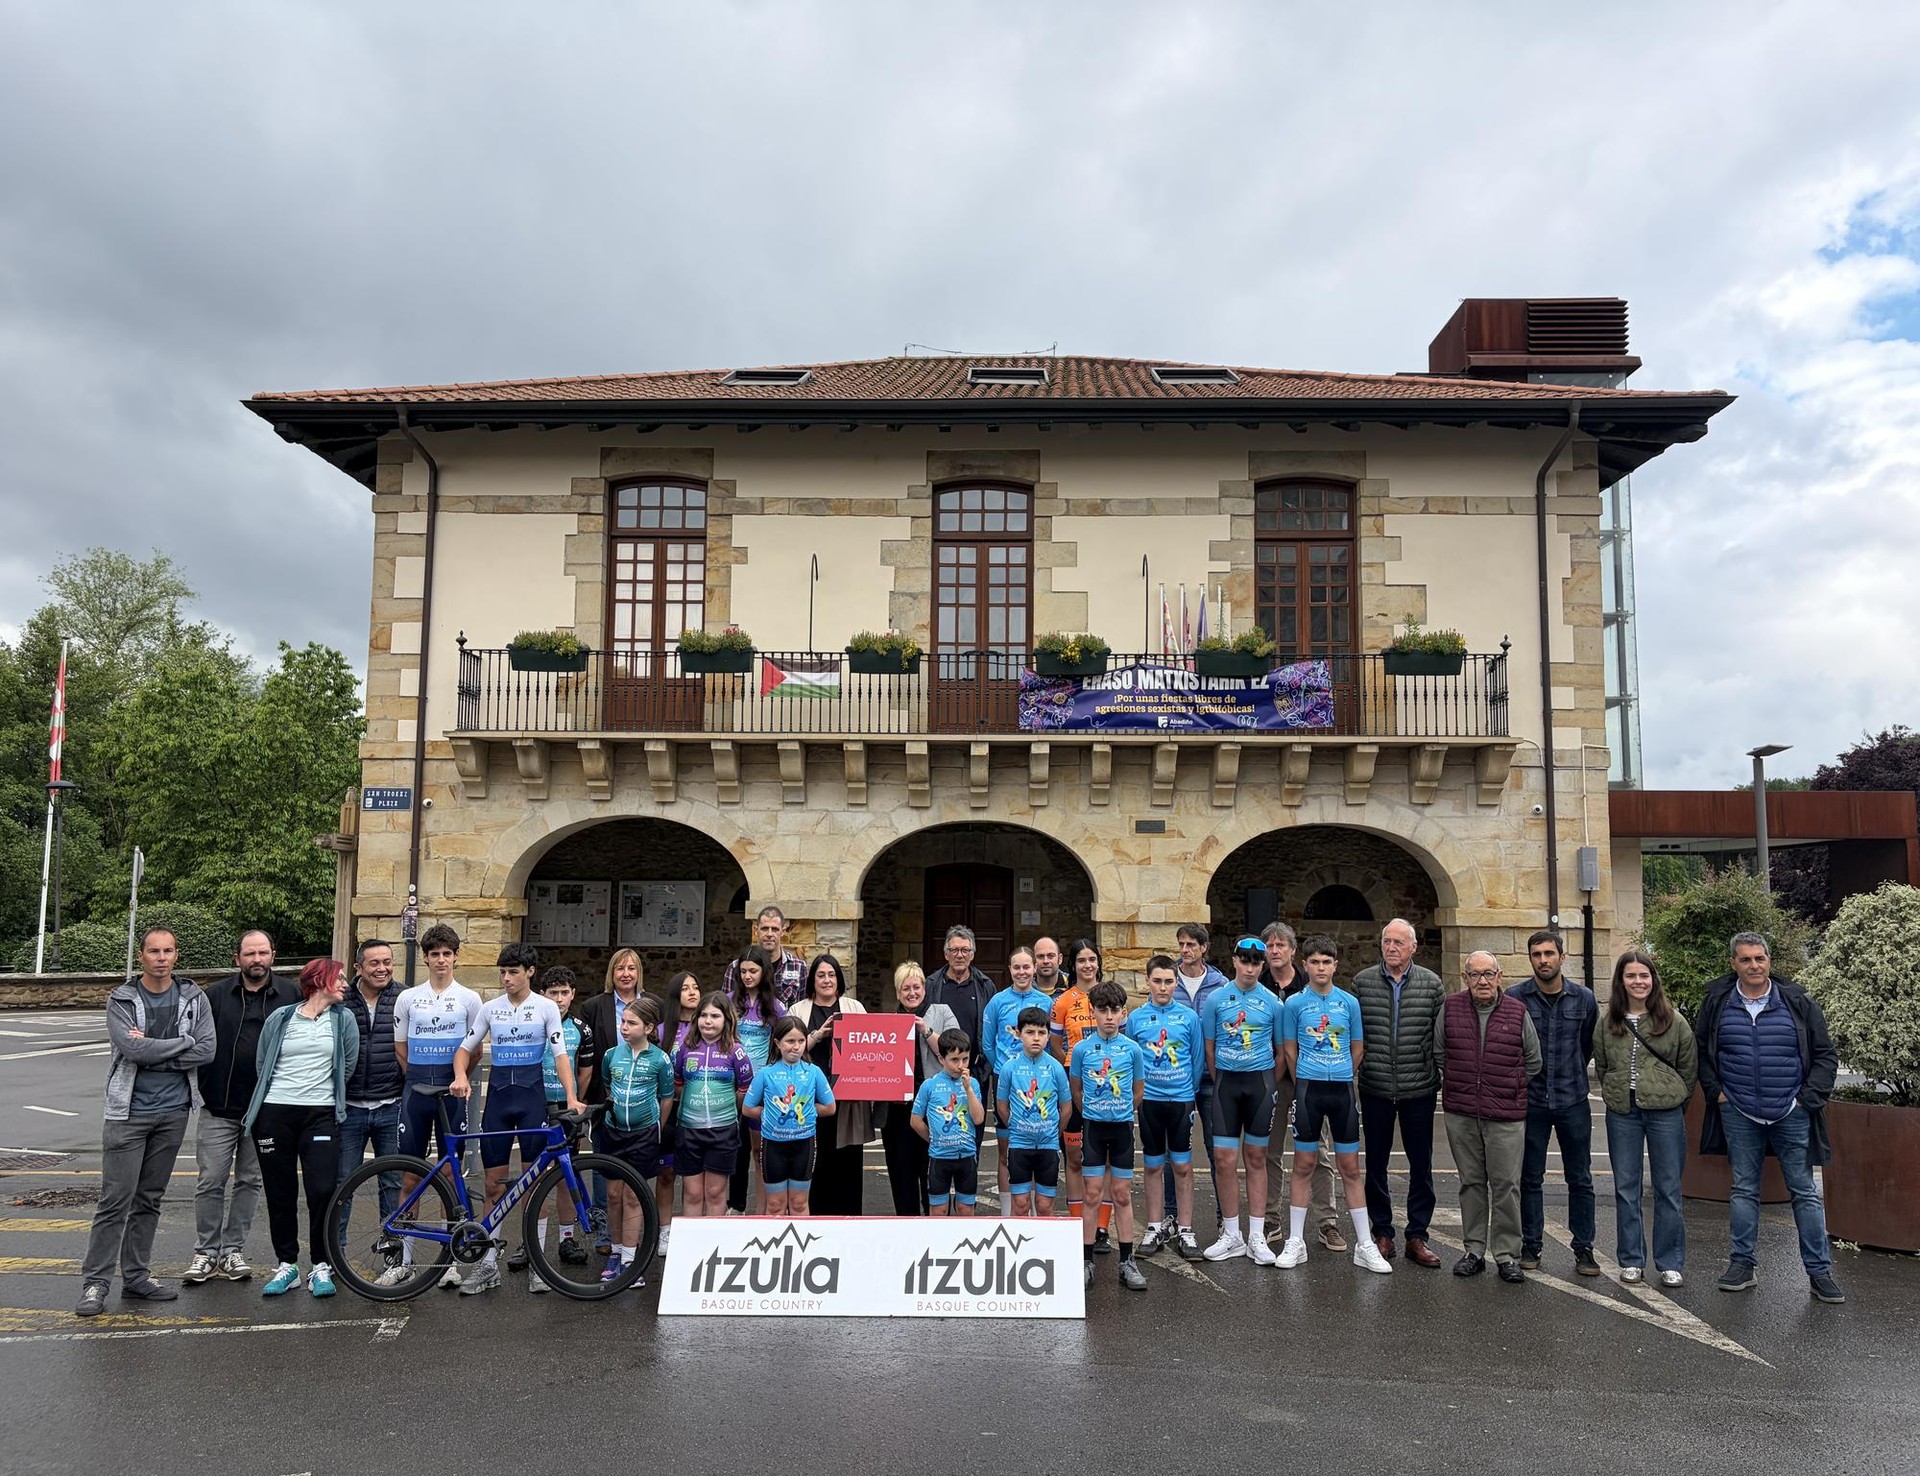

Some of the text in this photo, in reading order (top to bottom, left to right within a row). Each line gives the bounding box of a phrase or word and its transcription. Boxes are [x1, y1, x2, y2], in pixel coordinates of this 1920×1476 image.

[1114, 694, 1237, 704] ¡Por unas fiestas libres de
[1095, 704, 1146, 715] agresiones
[1147, 704, 1187, 713] sexistas
[1187, 706, 1195, 715] y
[848, 1031, 897, 1044] ETAPA 2
[849, 1051, 895, 1062] ABADIÑO
[841, 1076, 902, 1084] AMOREBIETA-ETXANO
[488, 1156, 542, 1228] GIANT
[701, 1298, 824, 1311] BASQUE COUNTRY
[916, 1300, 1041, 1313] BASQUE COUNTRY
